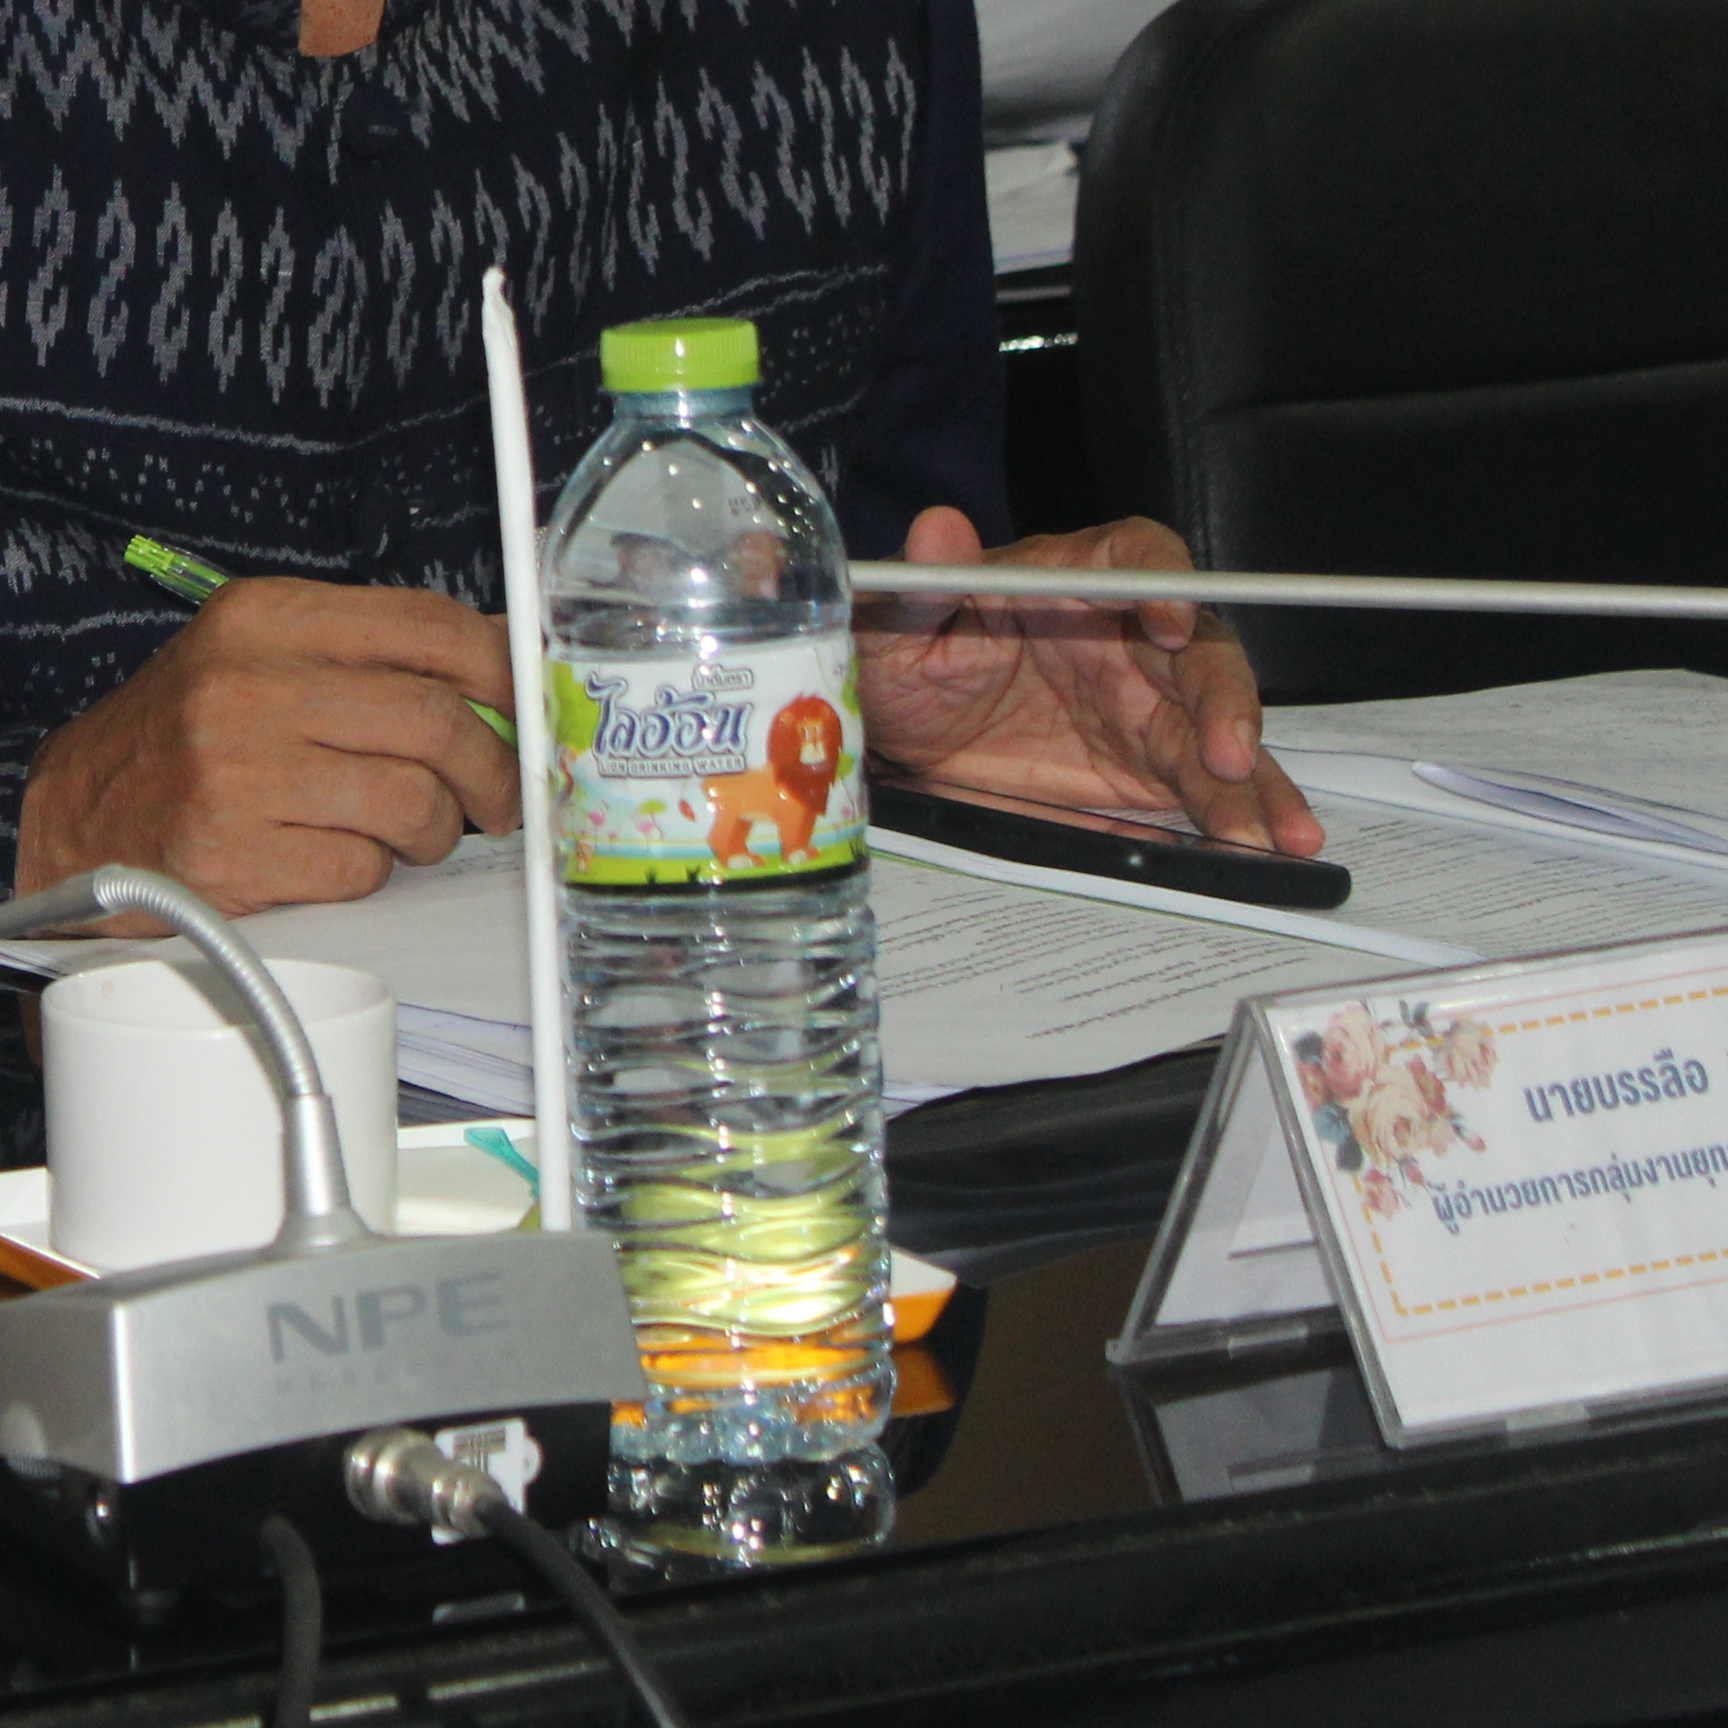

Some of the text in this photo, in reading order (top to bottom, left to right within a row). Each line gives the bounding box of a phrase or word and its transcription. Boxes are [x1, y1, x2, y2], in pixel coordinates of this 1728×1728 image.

[696, 757, 743, 772] WATER
[1524, 1047, 1710, 1123] นายบรรลือ
[265, 1270, 512, 1365] NPE
